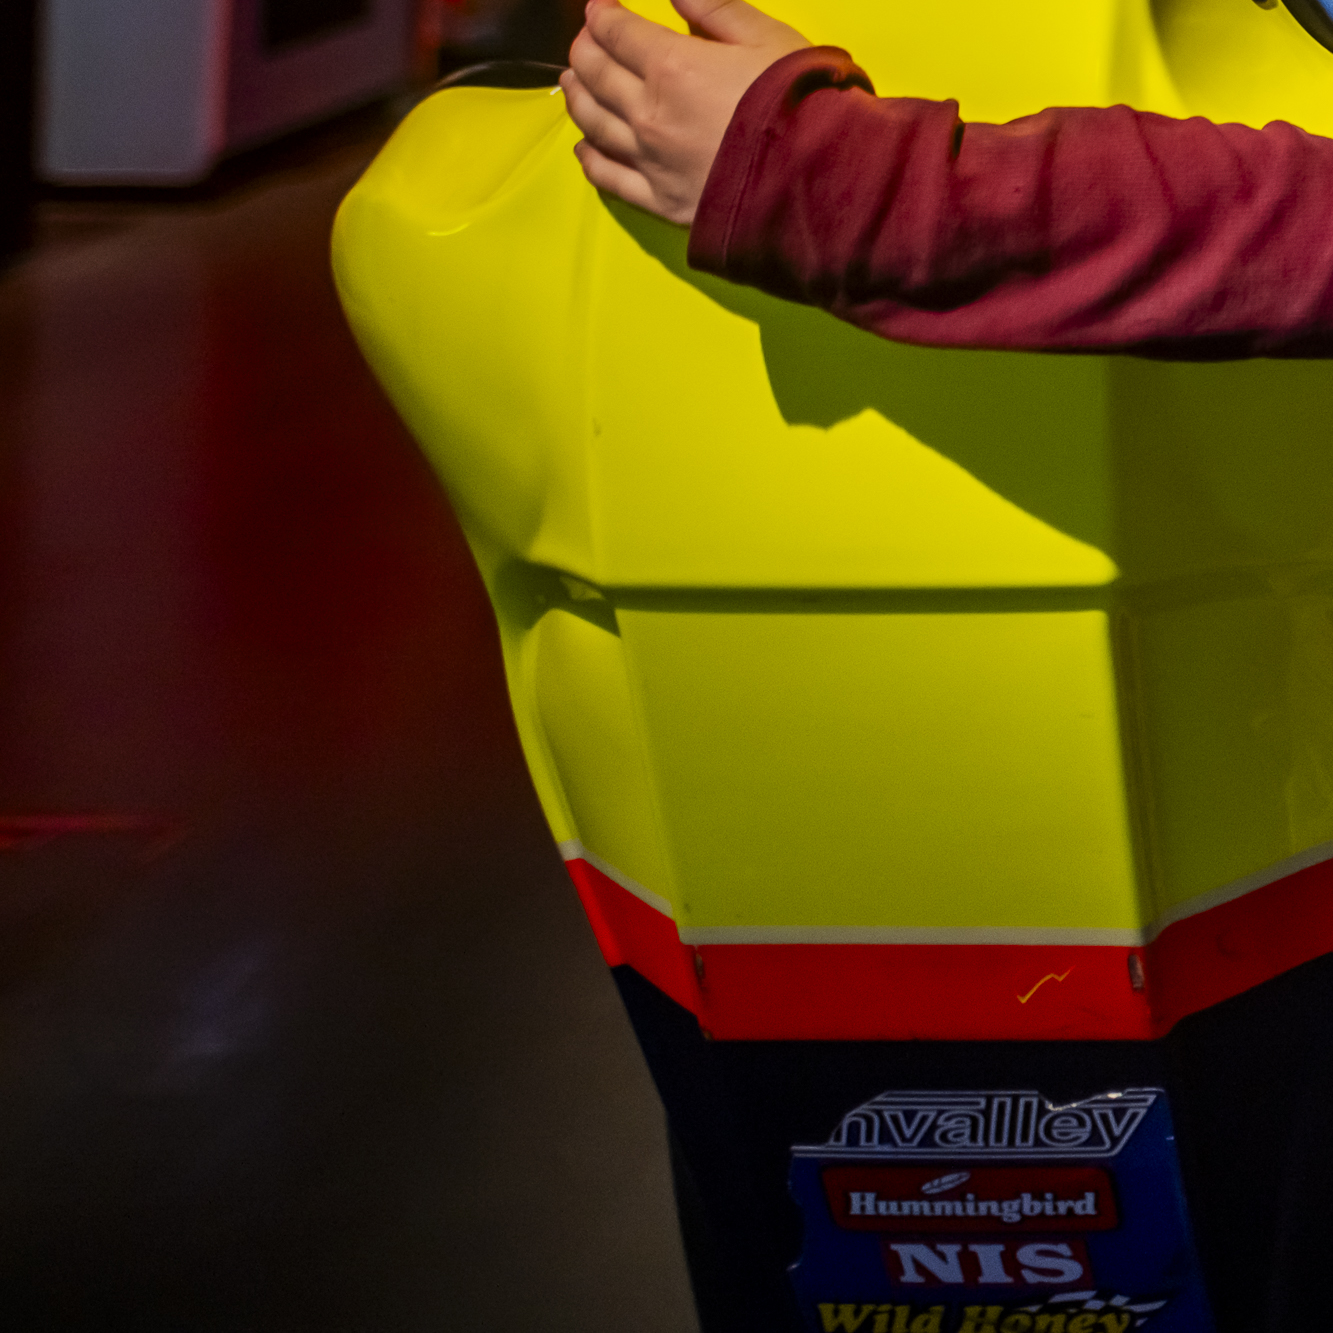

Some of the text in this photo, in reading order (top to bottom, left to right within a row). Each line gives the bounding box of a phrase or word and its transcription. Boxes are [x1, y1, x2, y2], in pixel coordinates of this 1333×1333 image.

[822, 1090, 1160, 1159] nvalley
[848, 1191, 1098, 1223] Hummingbird
[889, 1242, 1085, 1285] NIS
[816, 1302, 1132, 1333] Wild Honey
